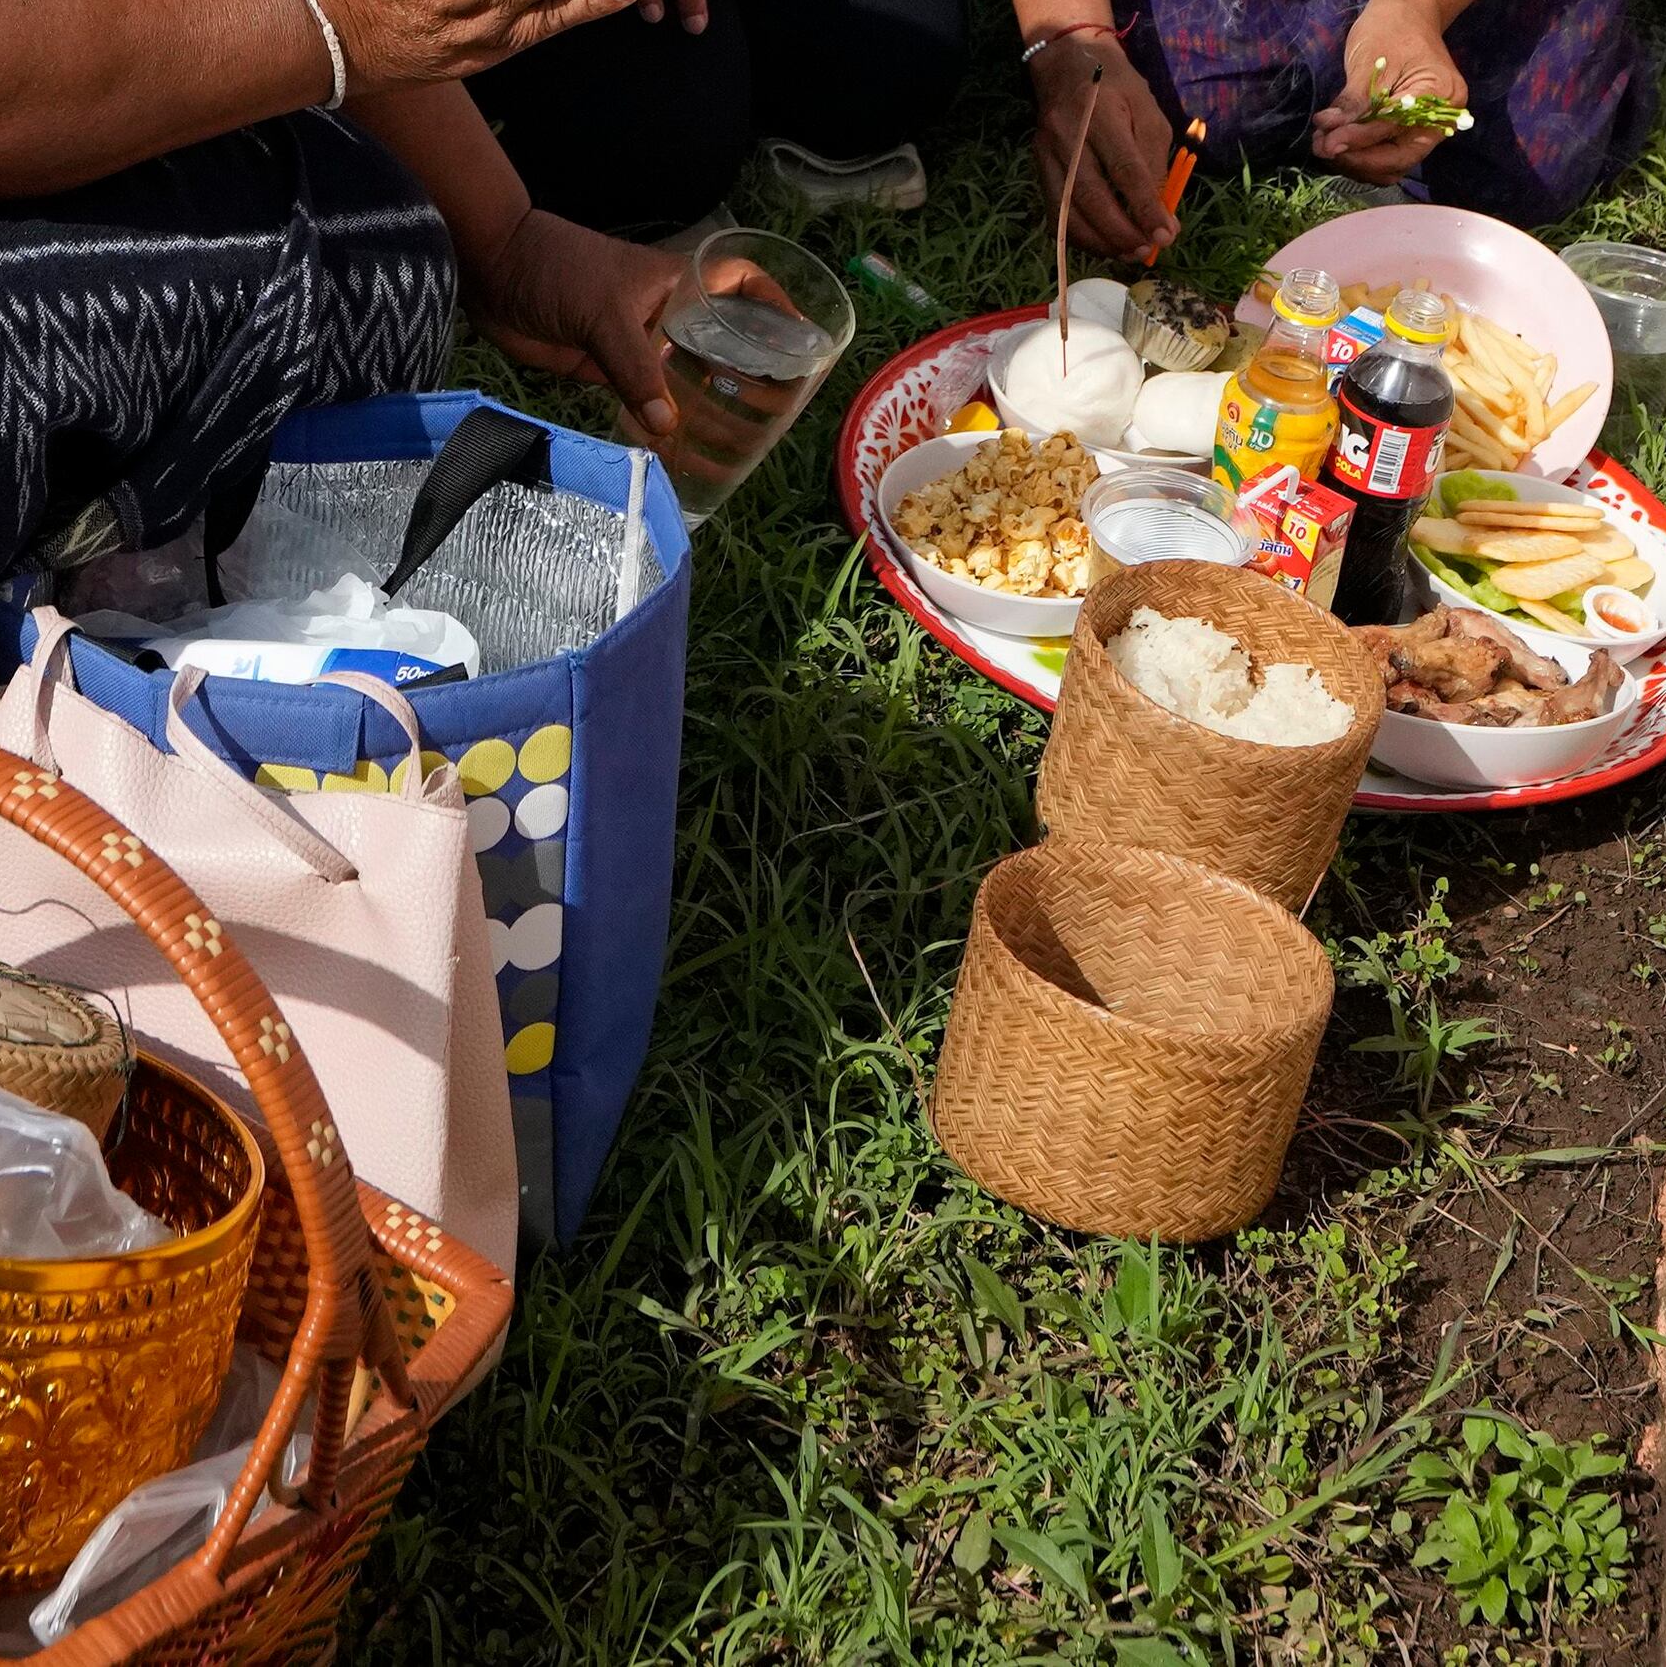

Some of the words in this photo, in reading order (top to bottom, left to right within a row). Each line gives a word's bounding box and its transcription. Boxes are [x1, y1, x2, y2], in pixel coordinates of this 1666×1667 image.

[1331, 340, 1354, 361] 10
[1251, 427, 1275, 449] 10
[1339, 423, 1370, 470] IG
[1288, 521, 1307, 540] 10
